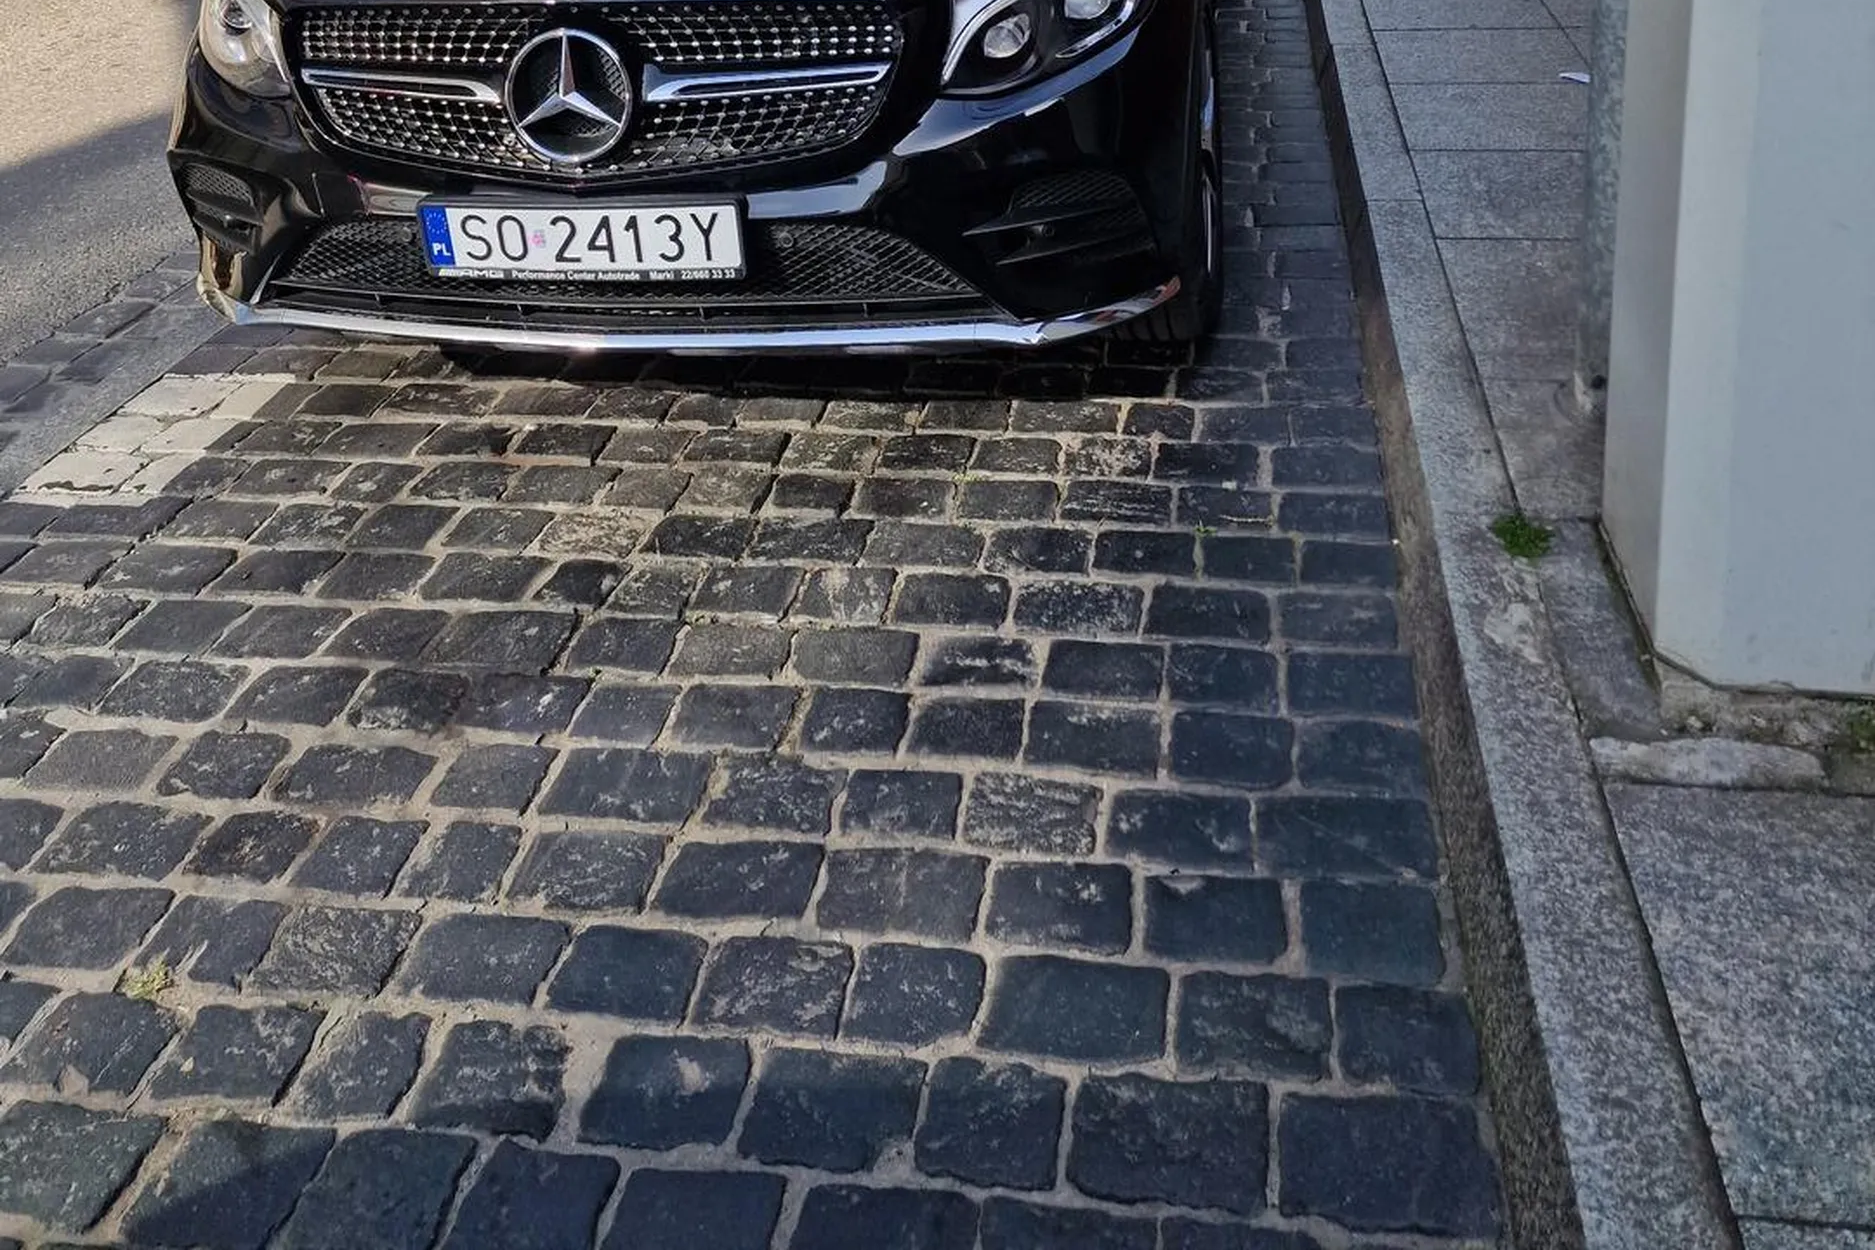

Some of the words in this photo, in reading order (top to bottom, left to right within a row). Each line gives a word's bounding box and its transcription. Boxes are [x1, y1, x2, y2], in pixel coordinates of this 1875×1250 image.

[433, 243, 451, 257] PL
[460, 214, 528, 263] SO
[549, 212, 718, 263] 2413Y
